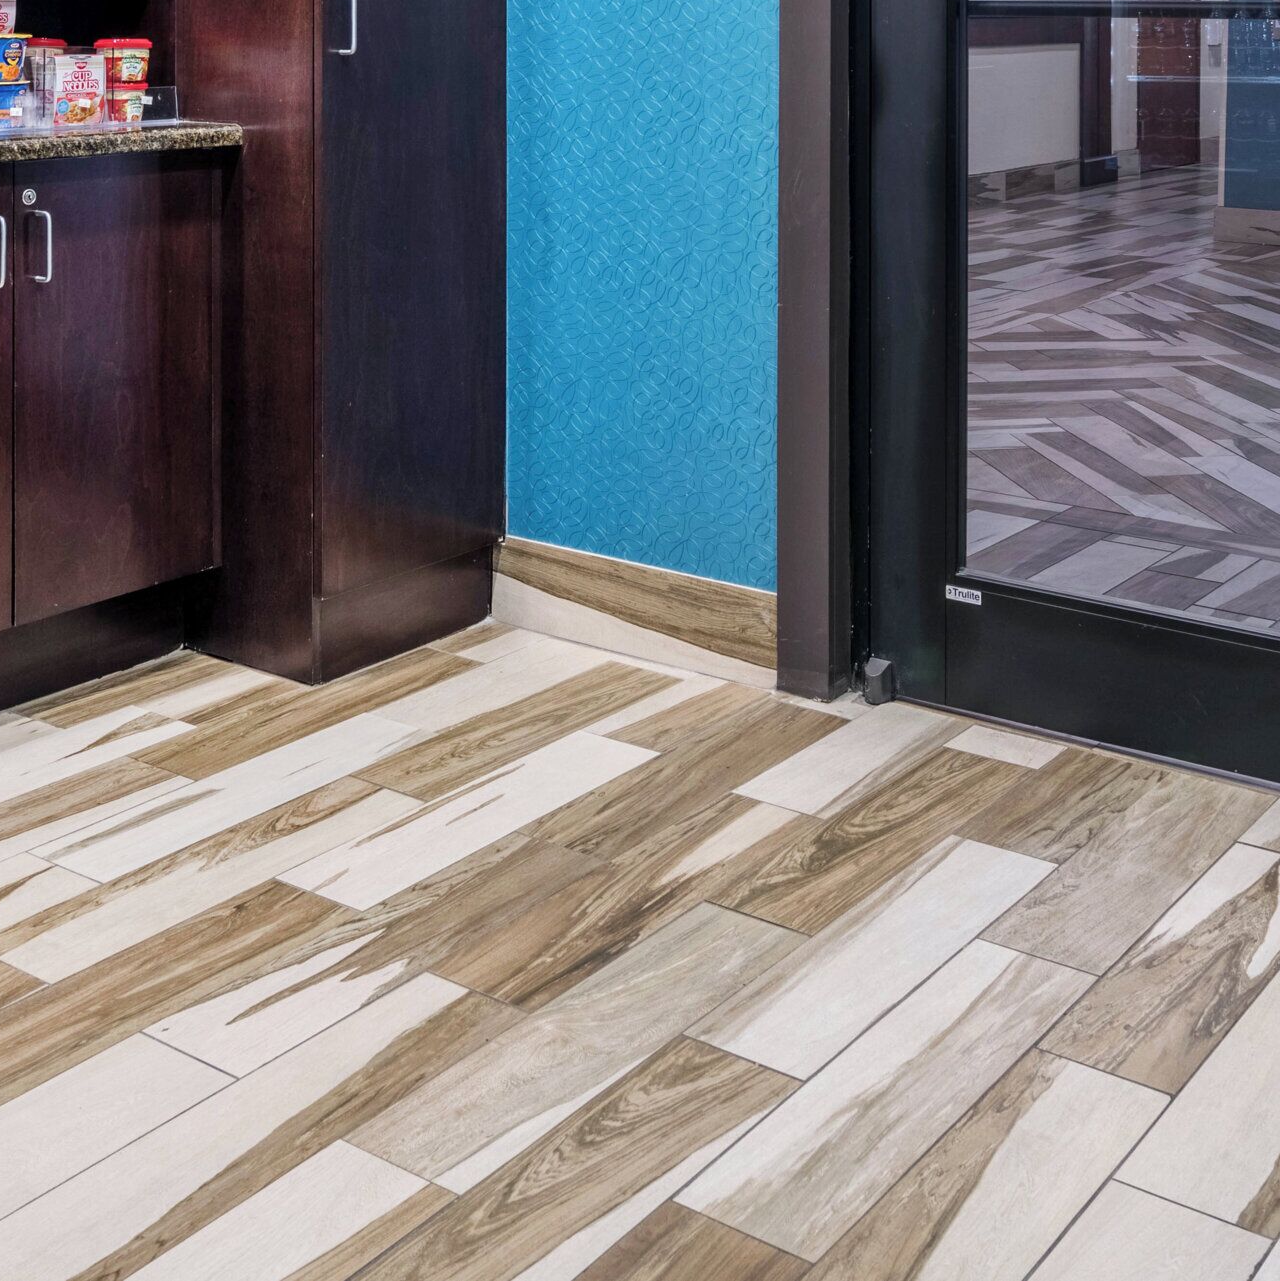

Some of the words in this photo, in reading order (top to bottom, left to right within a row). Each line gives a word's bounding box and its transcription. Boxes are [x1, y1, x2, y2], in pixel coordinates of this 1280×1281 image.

[71, 70, 93, 82] CUP
[62, 79, 100, 93] NOODLES
[952, 588, 980, 601] Trulite
